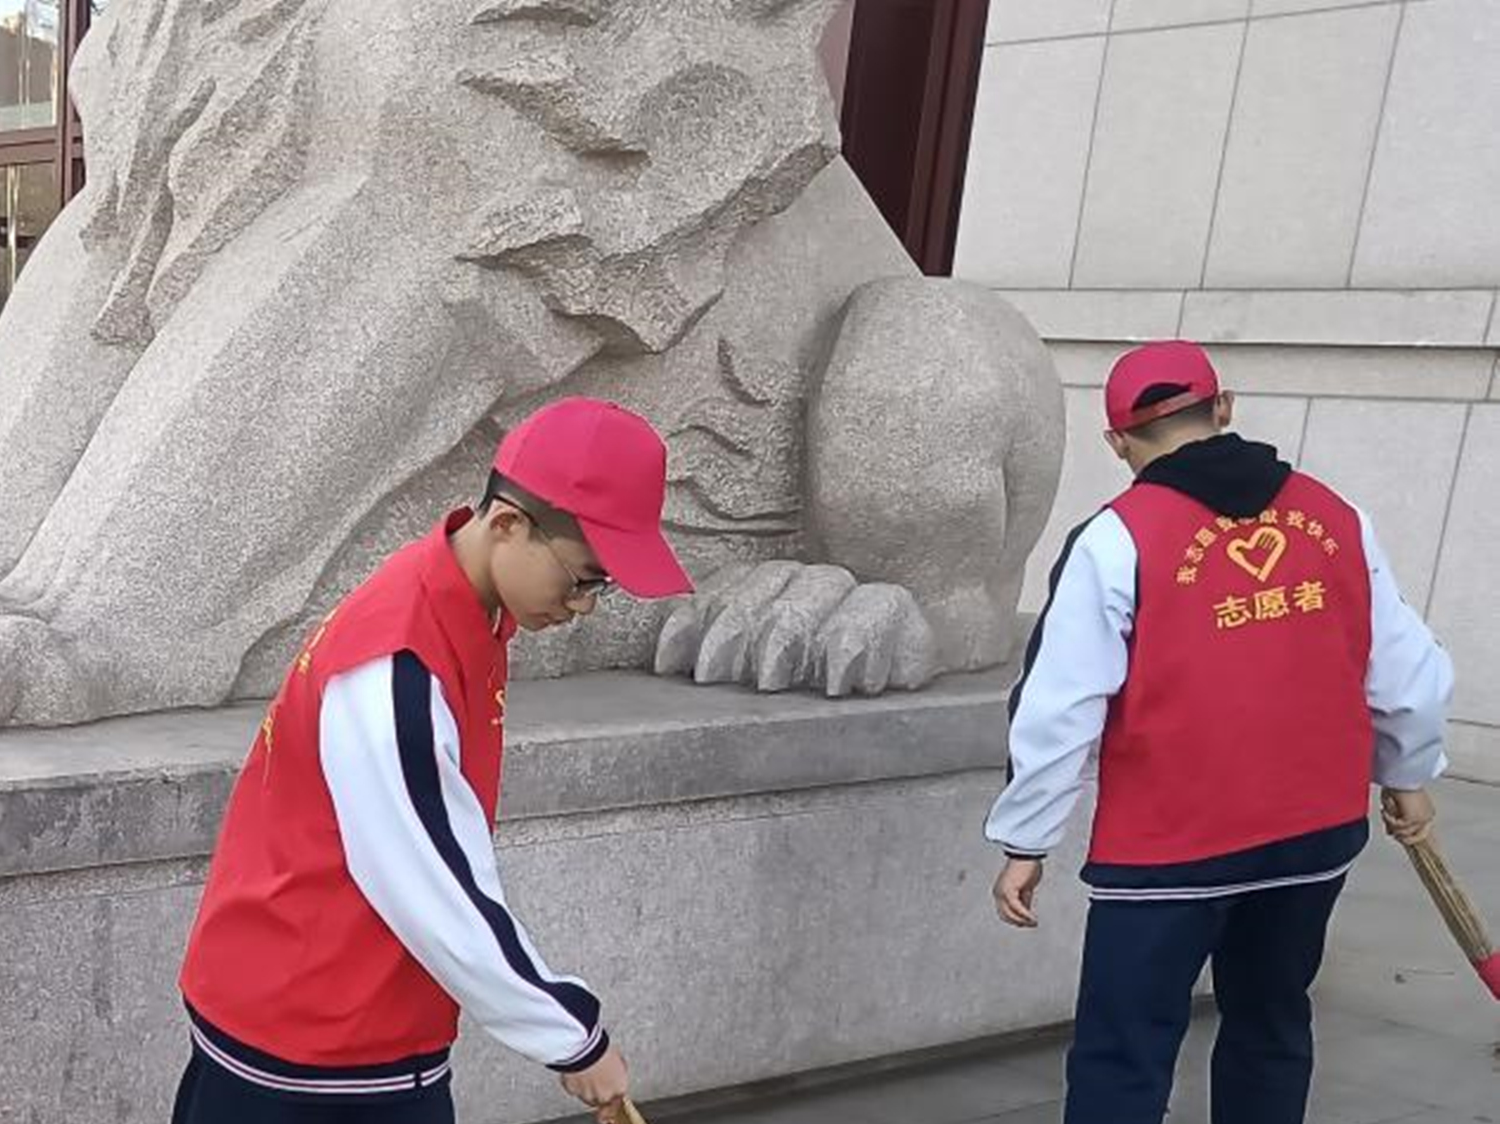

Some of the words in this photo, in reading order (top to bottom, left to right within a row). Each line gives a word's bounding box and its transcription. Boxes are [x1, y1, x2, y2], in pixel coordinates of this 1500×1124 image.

[1176, 508, 1340, 585] 我志愿我献我快乐
[1213, 580, 1327, 630] 志愿者
